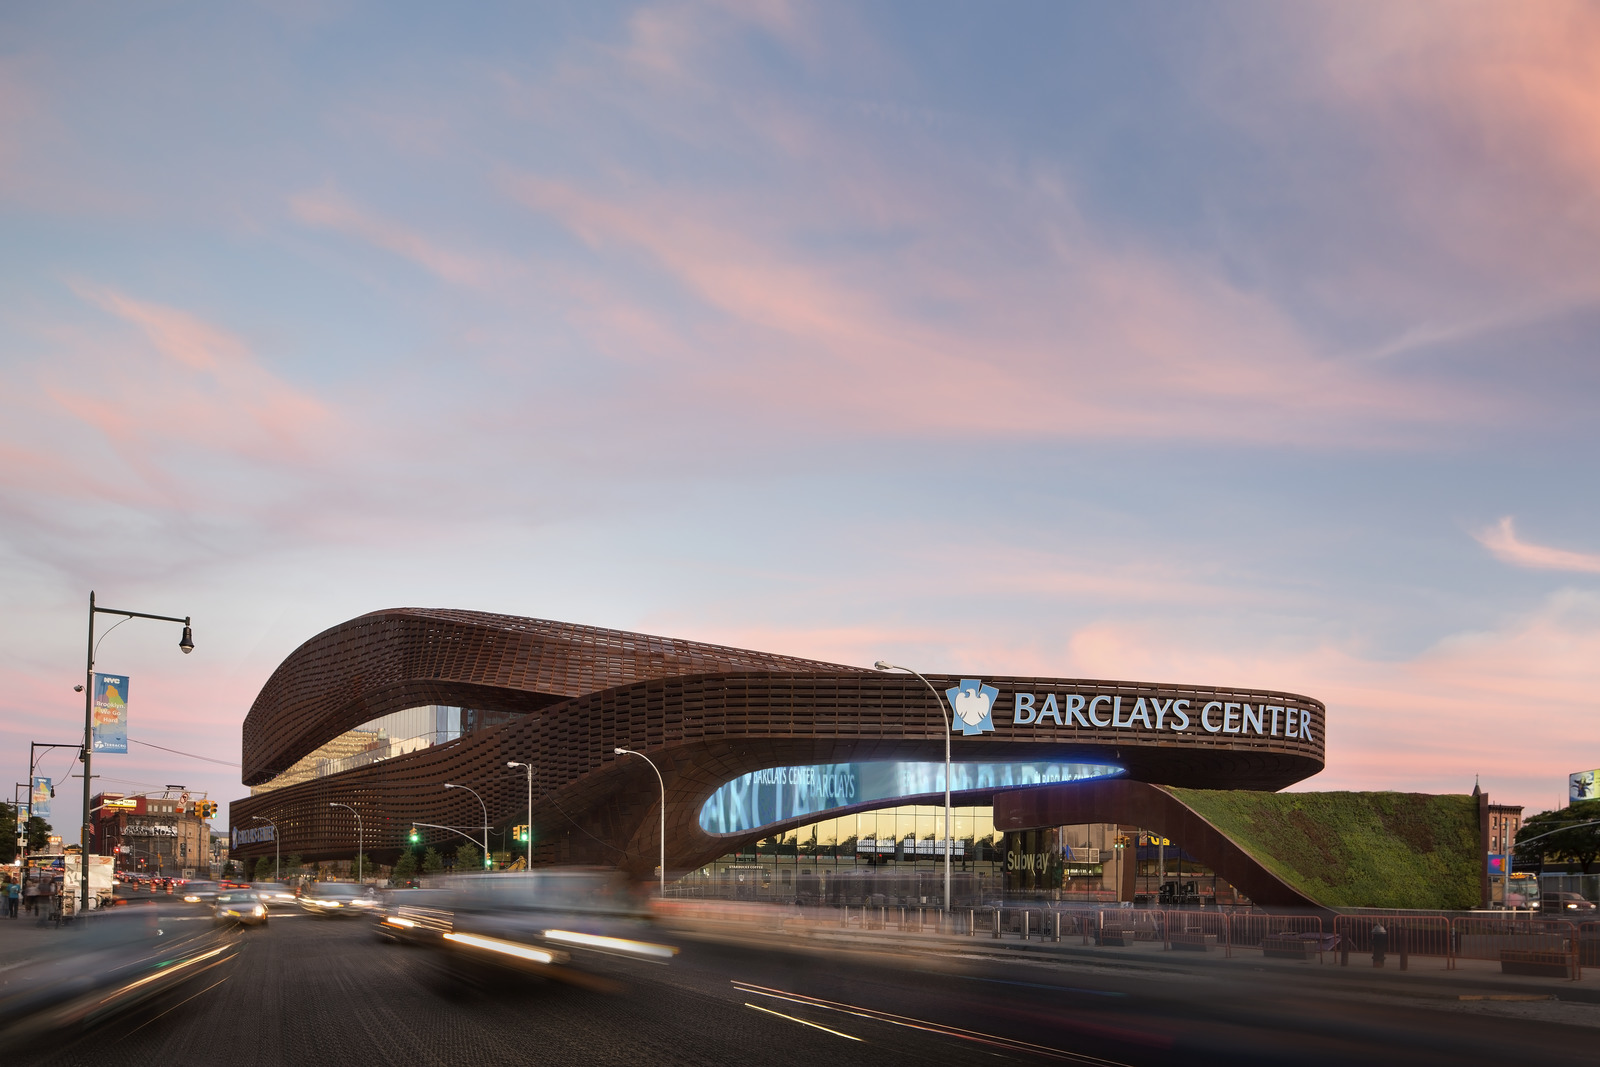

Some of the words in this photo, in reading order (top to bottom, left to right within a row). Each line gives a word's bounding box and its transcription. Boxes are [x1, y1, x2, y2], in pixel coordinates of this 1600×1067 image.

[96, 700, 126, 709] Brooklyn.
[1013, 692, 1190, 731] BARCLAYS
[1201, 701, 1314, 742] CENTER
[753, 767, 787, 785] BARCLAYS
[788, 766, 815, 785] CENTER
[810, 774, 855, 798] BARCLAYS
[1007, 850, 1051, 875] Subway
